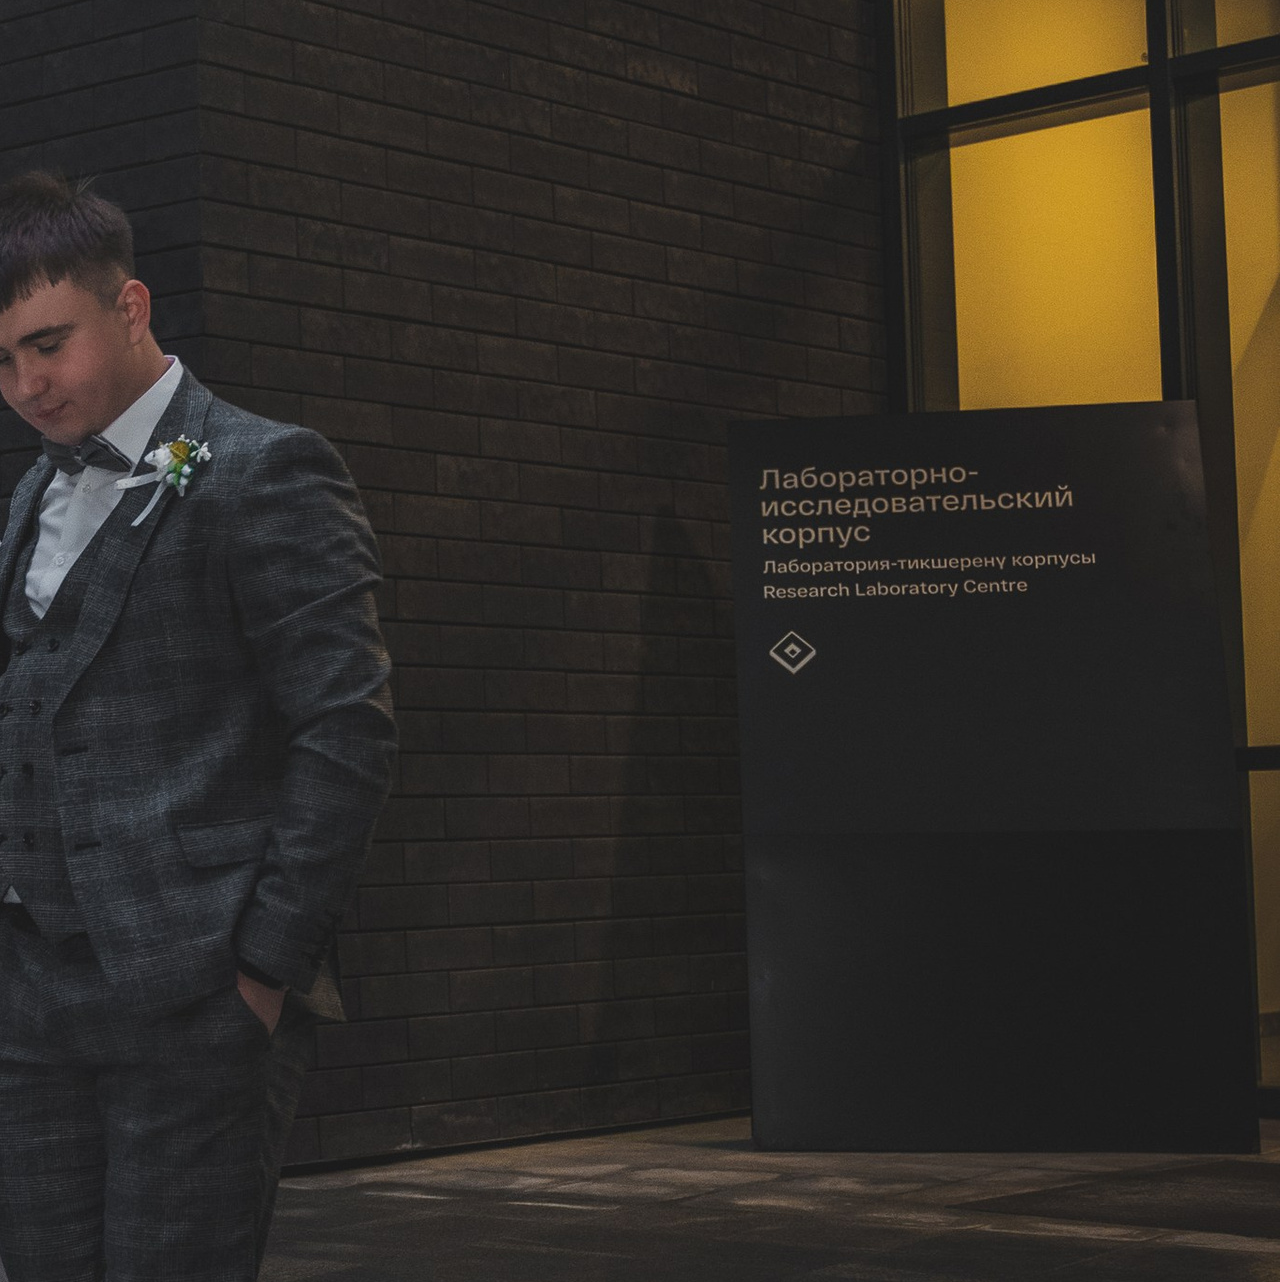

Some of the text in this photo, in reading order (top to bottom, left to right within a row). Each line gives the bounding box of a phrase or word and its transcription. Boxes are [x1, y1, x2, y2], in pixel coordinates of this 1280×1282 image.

[759, 466, 978, 492] Лабораторно-
[761, 484, 1073, 518] исследовательский
[763, 525, 870, 549] корпус
[1012, 552, 1096, 569] корпусы
[763, 578, 1028, 599] Research Laboratory Centre
